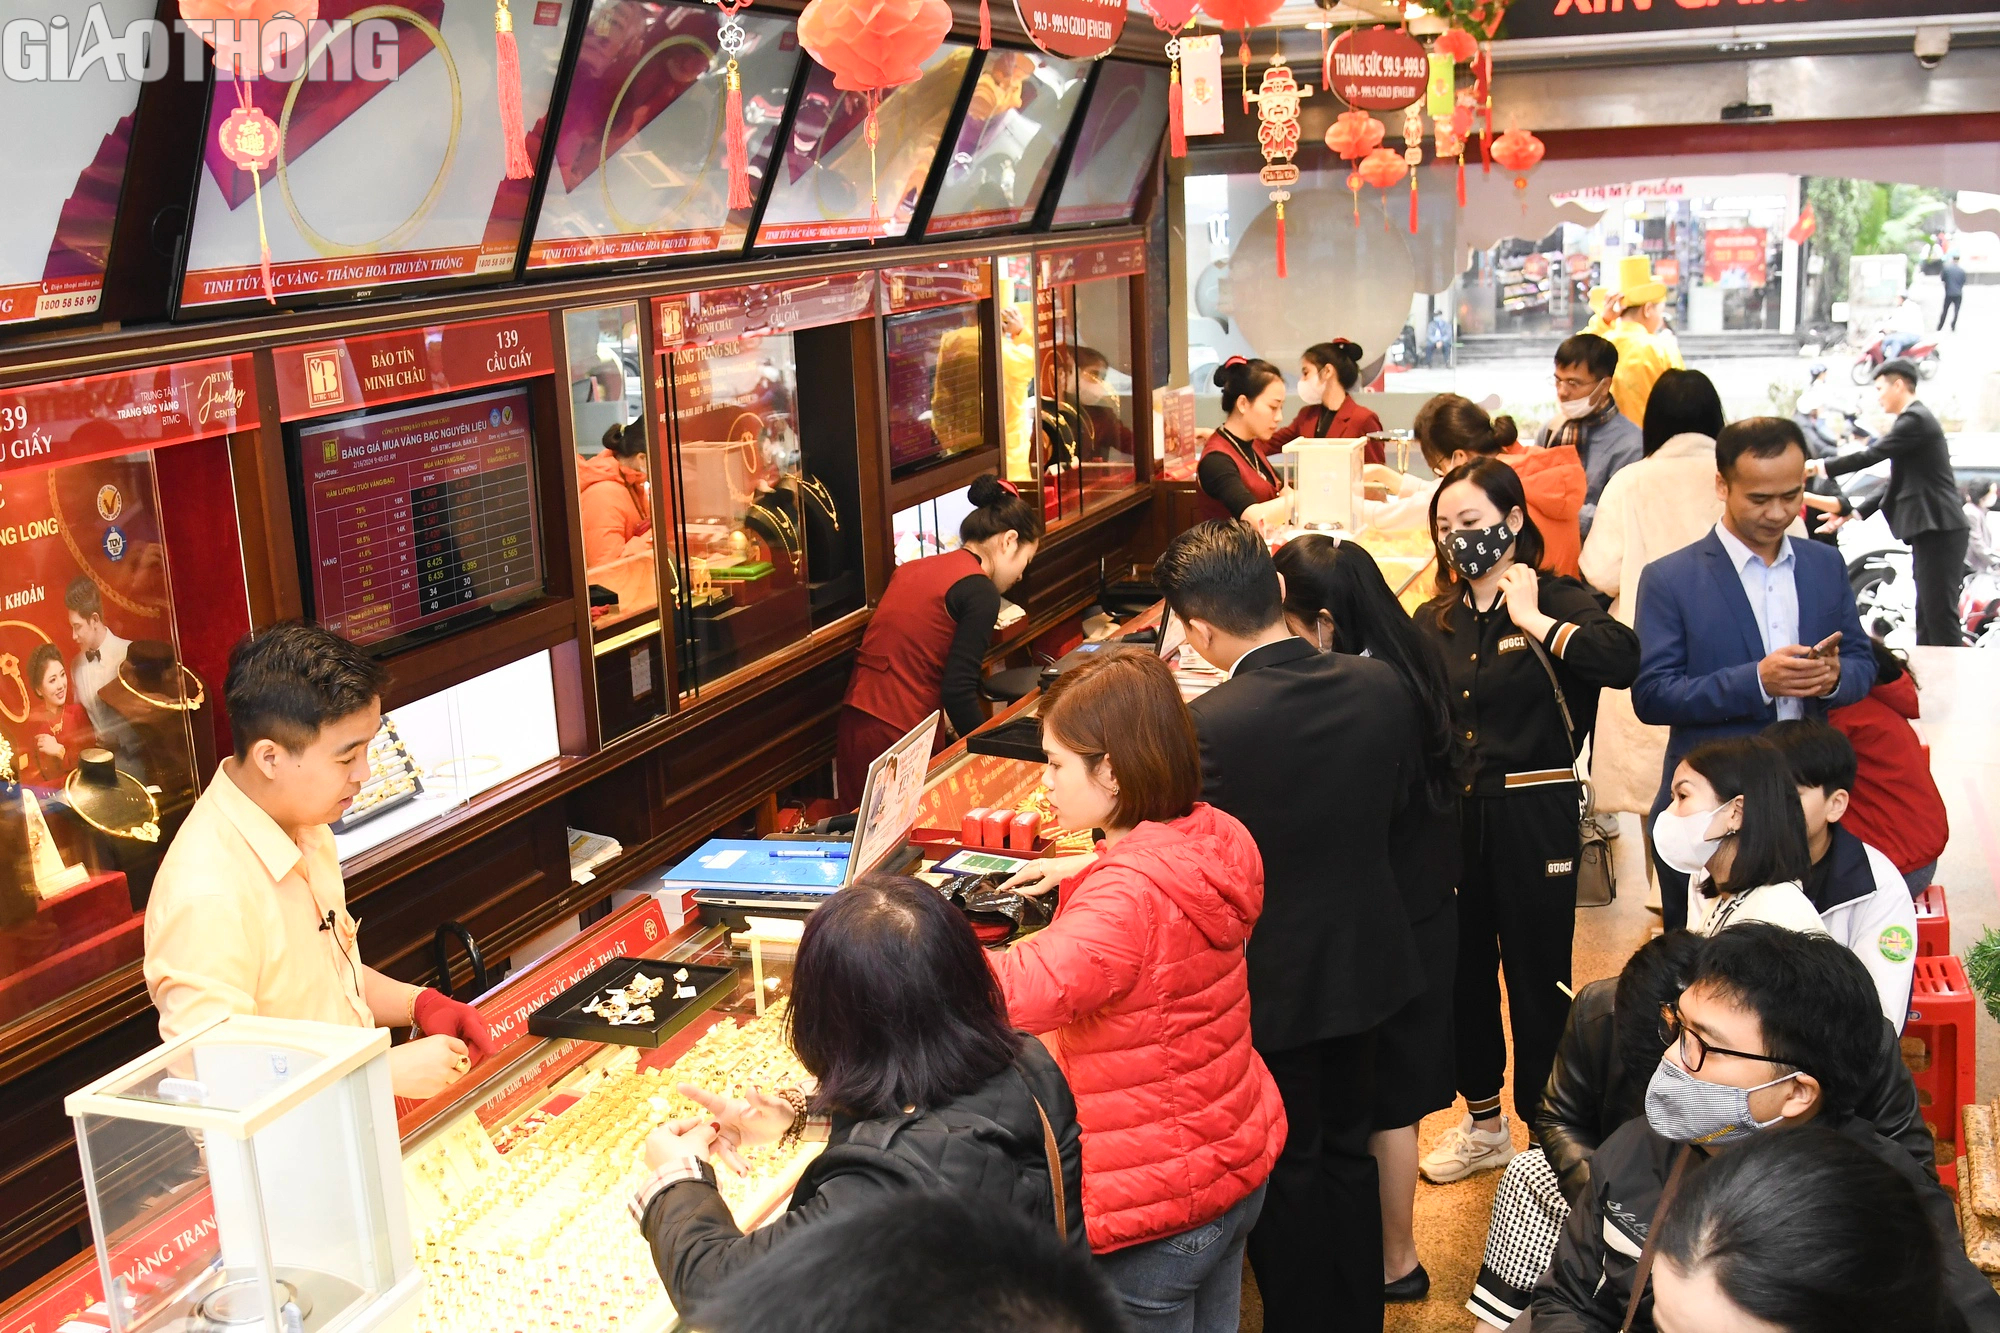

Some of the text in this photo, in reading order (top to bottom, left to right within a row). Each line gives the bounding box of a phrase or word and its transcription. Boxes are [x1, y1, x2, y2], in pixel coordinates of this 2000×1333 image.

[1033, 11, 1112, 40] 99.9 999.9 GOLD JEWELRY
[1335, 53, 1366, 76] TRANG
[1366, 50, 1383, 77] SỨC
[1376, 85, 1392, 98] GOLD
[542, 248, 561, 260] TINH
[562, 245, 579, 258] TÚY
[594, 241, 615, 255] VÀNG
[646, 239, 661, 251] HOA
[203, 280, 233, 294] TINH
[236, 275, 261, 291] TÚY
[288, 270, 319, 286] VÀNG
[327, 266, 363, 281] THĂNG
[365, 264, 387, 277] HOA
[41, 295, 97, 310] 1800 58 58 99
[778, 292, 792, 305] 139
[770, 305, 800, 326] CẦU GIẤY
[496, 329, 519, 350] 139
[371, 345, 415, 369] BẢO TÍN
[486, 346, 532, 373] CẦU GIẤY
[696, 343, 723, 361] TRANG
[211, 370, 234, 384] BTMC
[364, 367, 427, 392] MINH CHÂU
[140, 386, 179, 402] TRUNG TÂM
[197, 375, 246, 425] Jewelry
[0, 405, 28, 433] 39
[117, 400, 179, 420] TRANG SỨC VÀNG
[162, 414, 181, 426] BTMC
[214, 408, 237, 419] CENTER
[11, 427, 52, 459] GIẤY
[341, 420, 487, 460] BẢNG GIÁ MUA VÀNG BẠC NGUYÊN LIỆU
[19, 517, 59, 542] LONG
[502, 535, 517, 546] 6.555
[322, 558, 337, 567] VÀNG
[426, 557, 443, 569] 6.425
[503, 549, 518, 559] 6.565
[428, 571, 444, 583] 6.435
[462, 561, 477, 572] 6.395
[504, 565, 509, 573] 0
[5, 584, 45, 610] KHOẢN
[429, 577, 510, 597] 34 30 0
[430, 601, 439, 610] 40
[464, 590, 473, 599] 40
[1499, 636, 1525, 651] GUCCI
[1547, 860, 1573, 874] GUCCI
[488, 1014, 515, 1041] ÀNG
[513, 992, 551, 1022] TRANG
[507, 1079, 523, 1098] SANG
[123, 1244, 174, 1285] VÀNG
